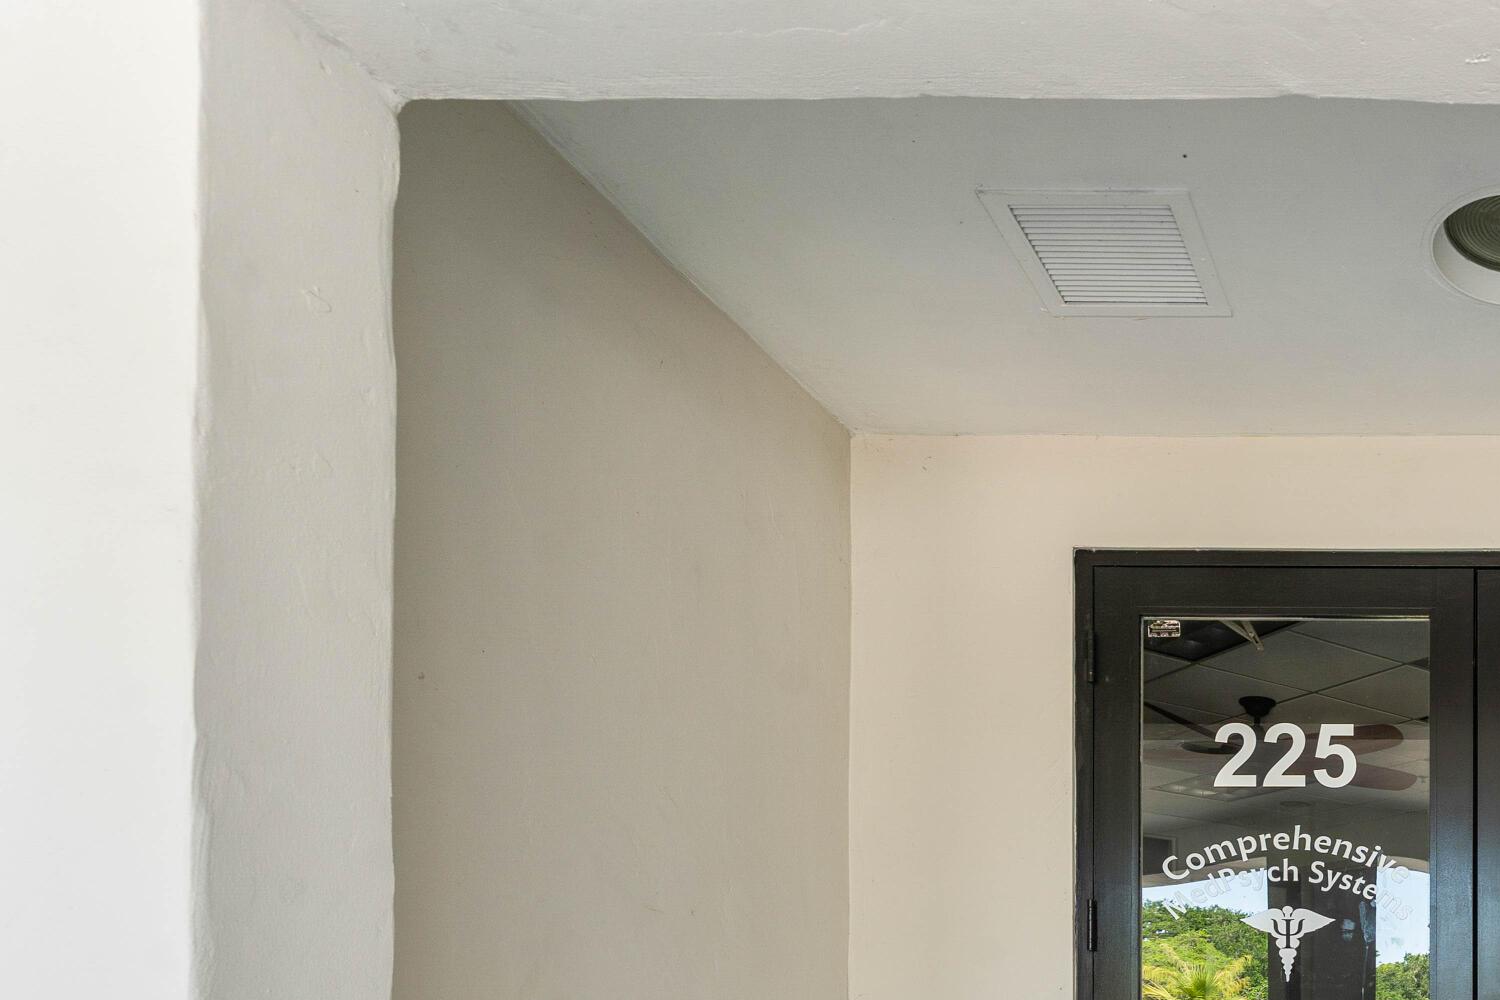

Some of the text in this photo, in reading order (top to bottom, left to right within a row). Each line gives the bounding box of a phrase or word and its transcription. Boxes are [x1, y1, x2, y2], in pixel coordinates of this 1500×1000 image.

[1213, 722, 1357, 788] 225
[1161, 824, 1410, 881] Comprehensive
[1162, 858, 1415, 921] MedPsych Systems
